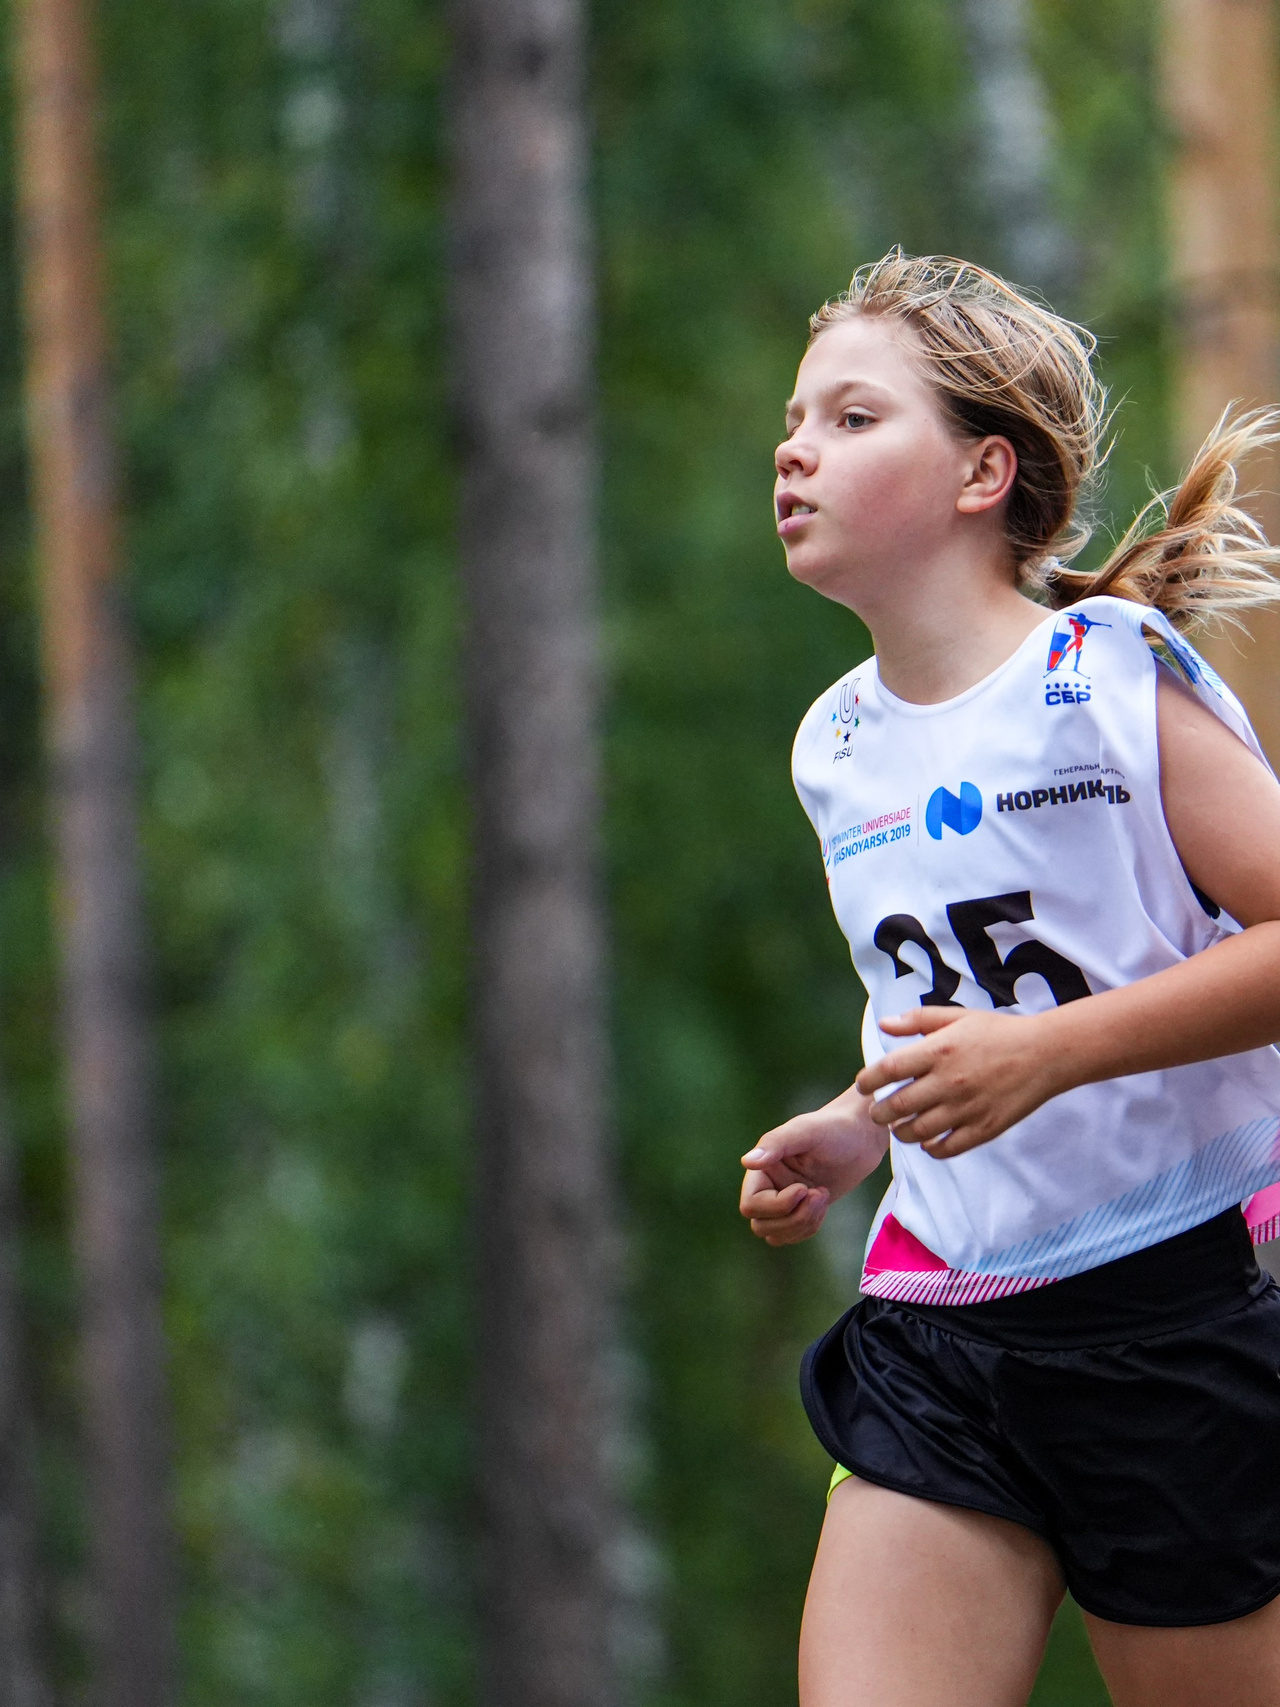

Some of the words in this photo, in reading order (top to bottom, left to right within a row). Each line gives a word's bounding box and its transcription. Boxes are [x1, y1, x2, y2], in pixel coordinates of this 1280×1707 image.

[1045, 691, 1091, 705] СБР
[1053, 763, 1100, 776] ГЕНЕРАЛЬН
[997, 779, 1131, 812] НОРНИКЛЬ
[862, 807, 911, 834] UNIVERSIADE
[890, 823, 911, 842] 2019
